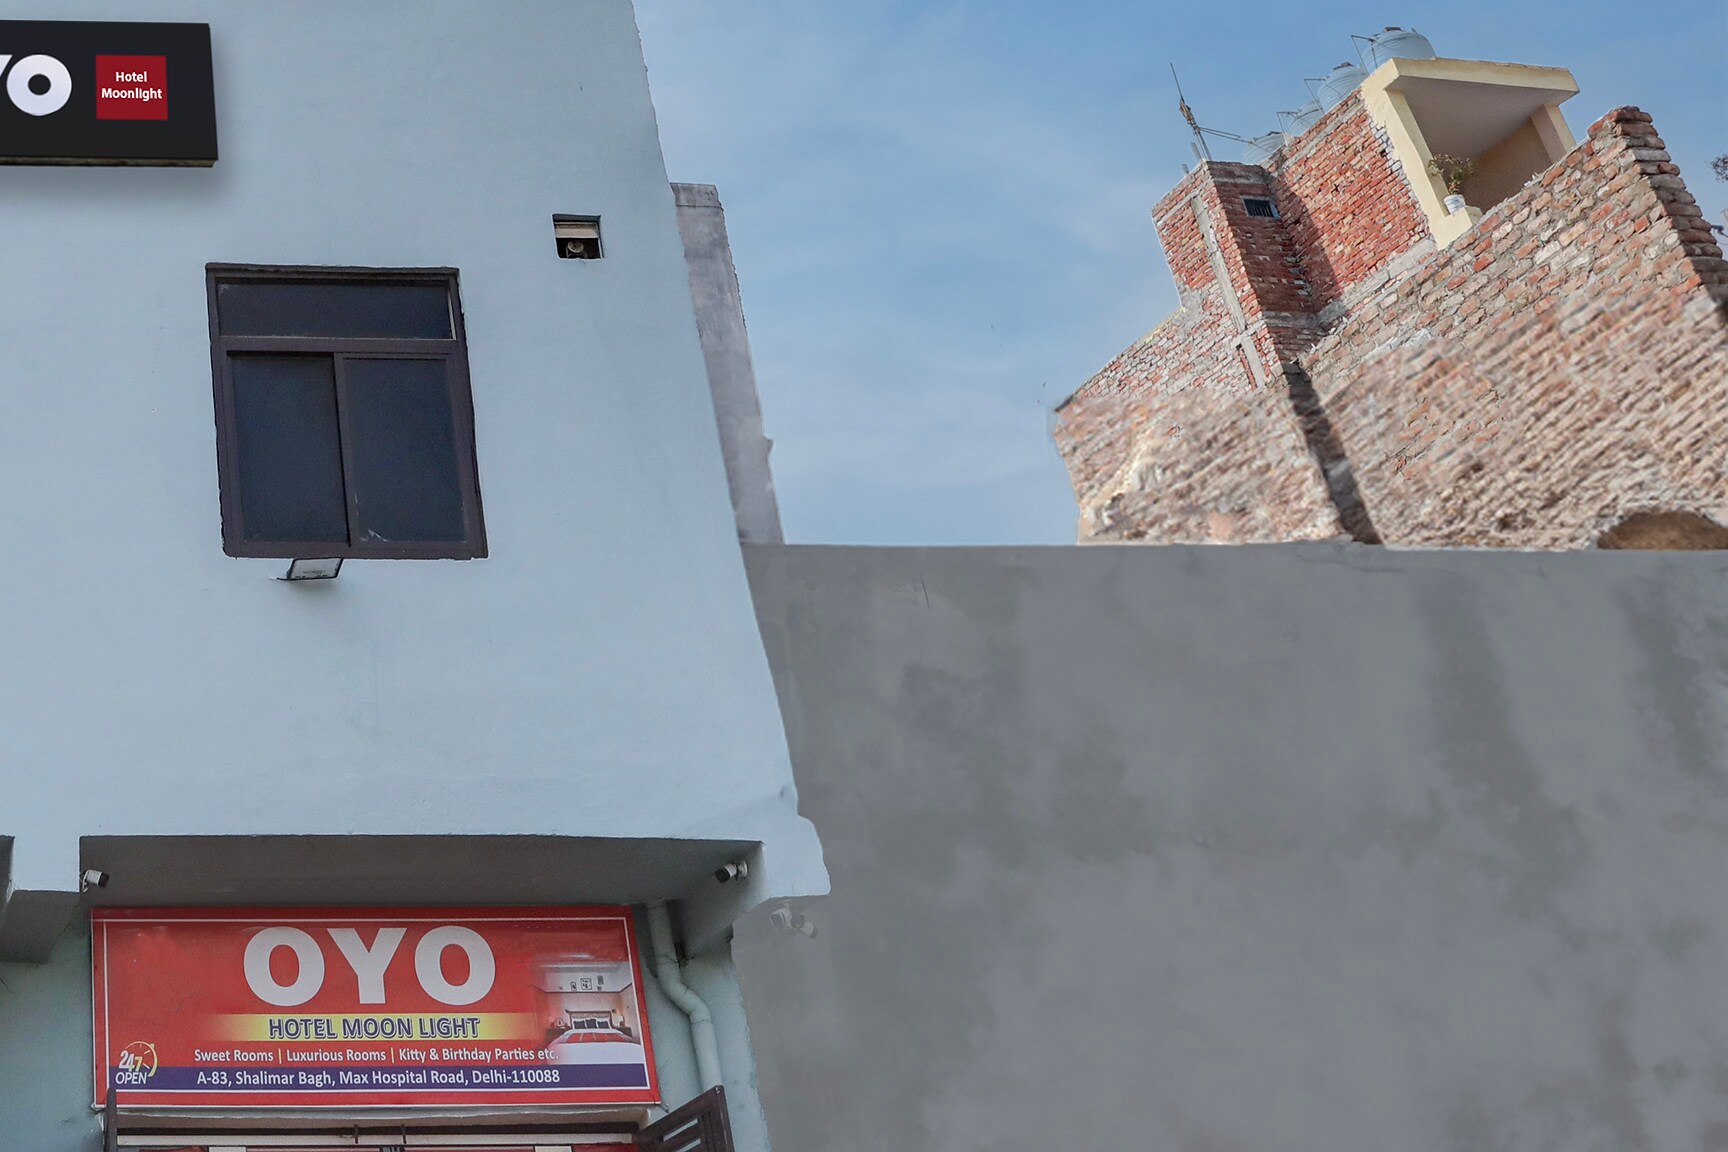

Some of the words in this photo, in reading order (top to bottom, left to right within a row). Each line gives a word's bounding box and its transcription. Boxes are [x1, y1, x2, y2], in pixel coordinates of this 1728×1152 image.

[115, 70, 148, 82] Hotel
[101, 87, 163, 102] Moonlight
[243, 925, 496, 1007] OYO
[268, 1018, 338, 1040] HOTEL
[342, 1017, 413, 1039] MOON
[418, 1017, 481, 1038] LIGHT
[194, 1049, 231, 1062] Sweet
[233, 1049, 274, 1062] Rooms
[286, 1049, 343, 1061] Luxurious
[346, 1049, 387, 1061] Rooms
[399, 1048, 426, 1063] Kitty
[429, 1048, 439, 1061] &
[442, 1048, 492, 1063] Birthday
[494, 1048, 535, 1061] Parties
[537, 1048, 559, 1060] etc.
[115, 1071, 148, 1085] OPEN
[197, 1071, 232, 1087] A-83,
[235, 1070, 295, 1085] Shalimar
[298, 1070, 336, 1087] Bagh,
[339, 1070, 369, 1084] Max
[372, 1069, 427, 1087] Hospital
[430, 1070, 469, 1086] Road,
[472, 1069, 561, 1084] Delhi-110088
